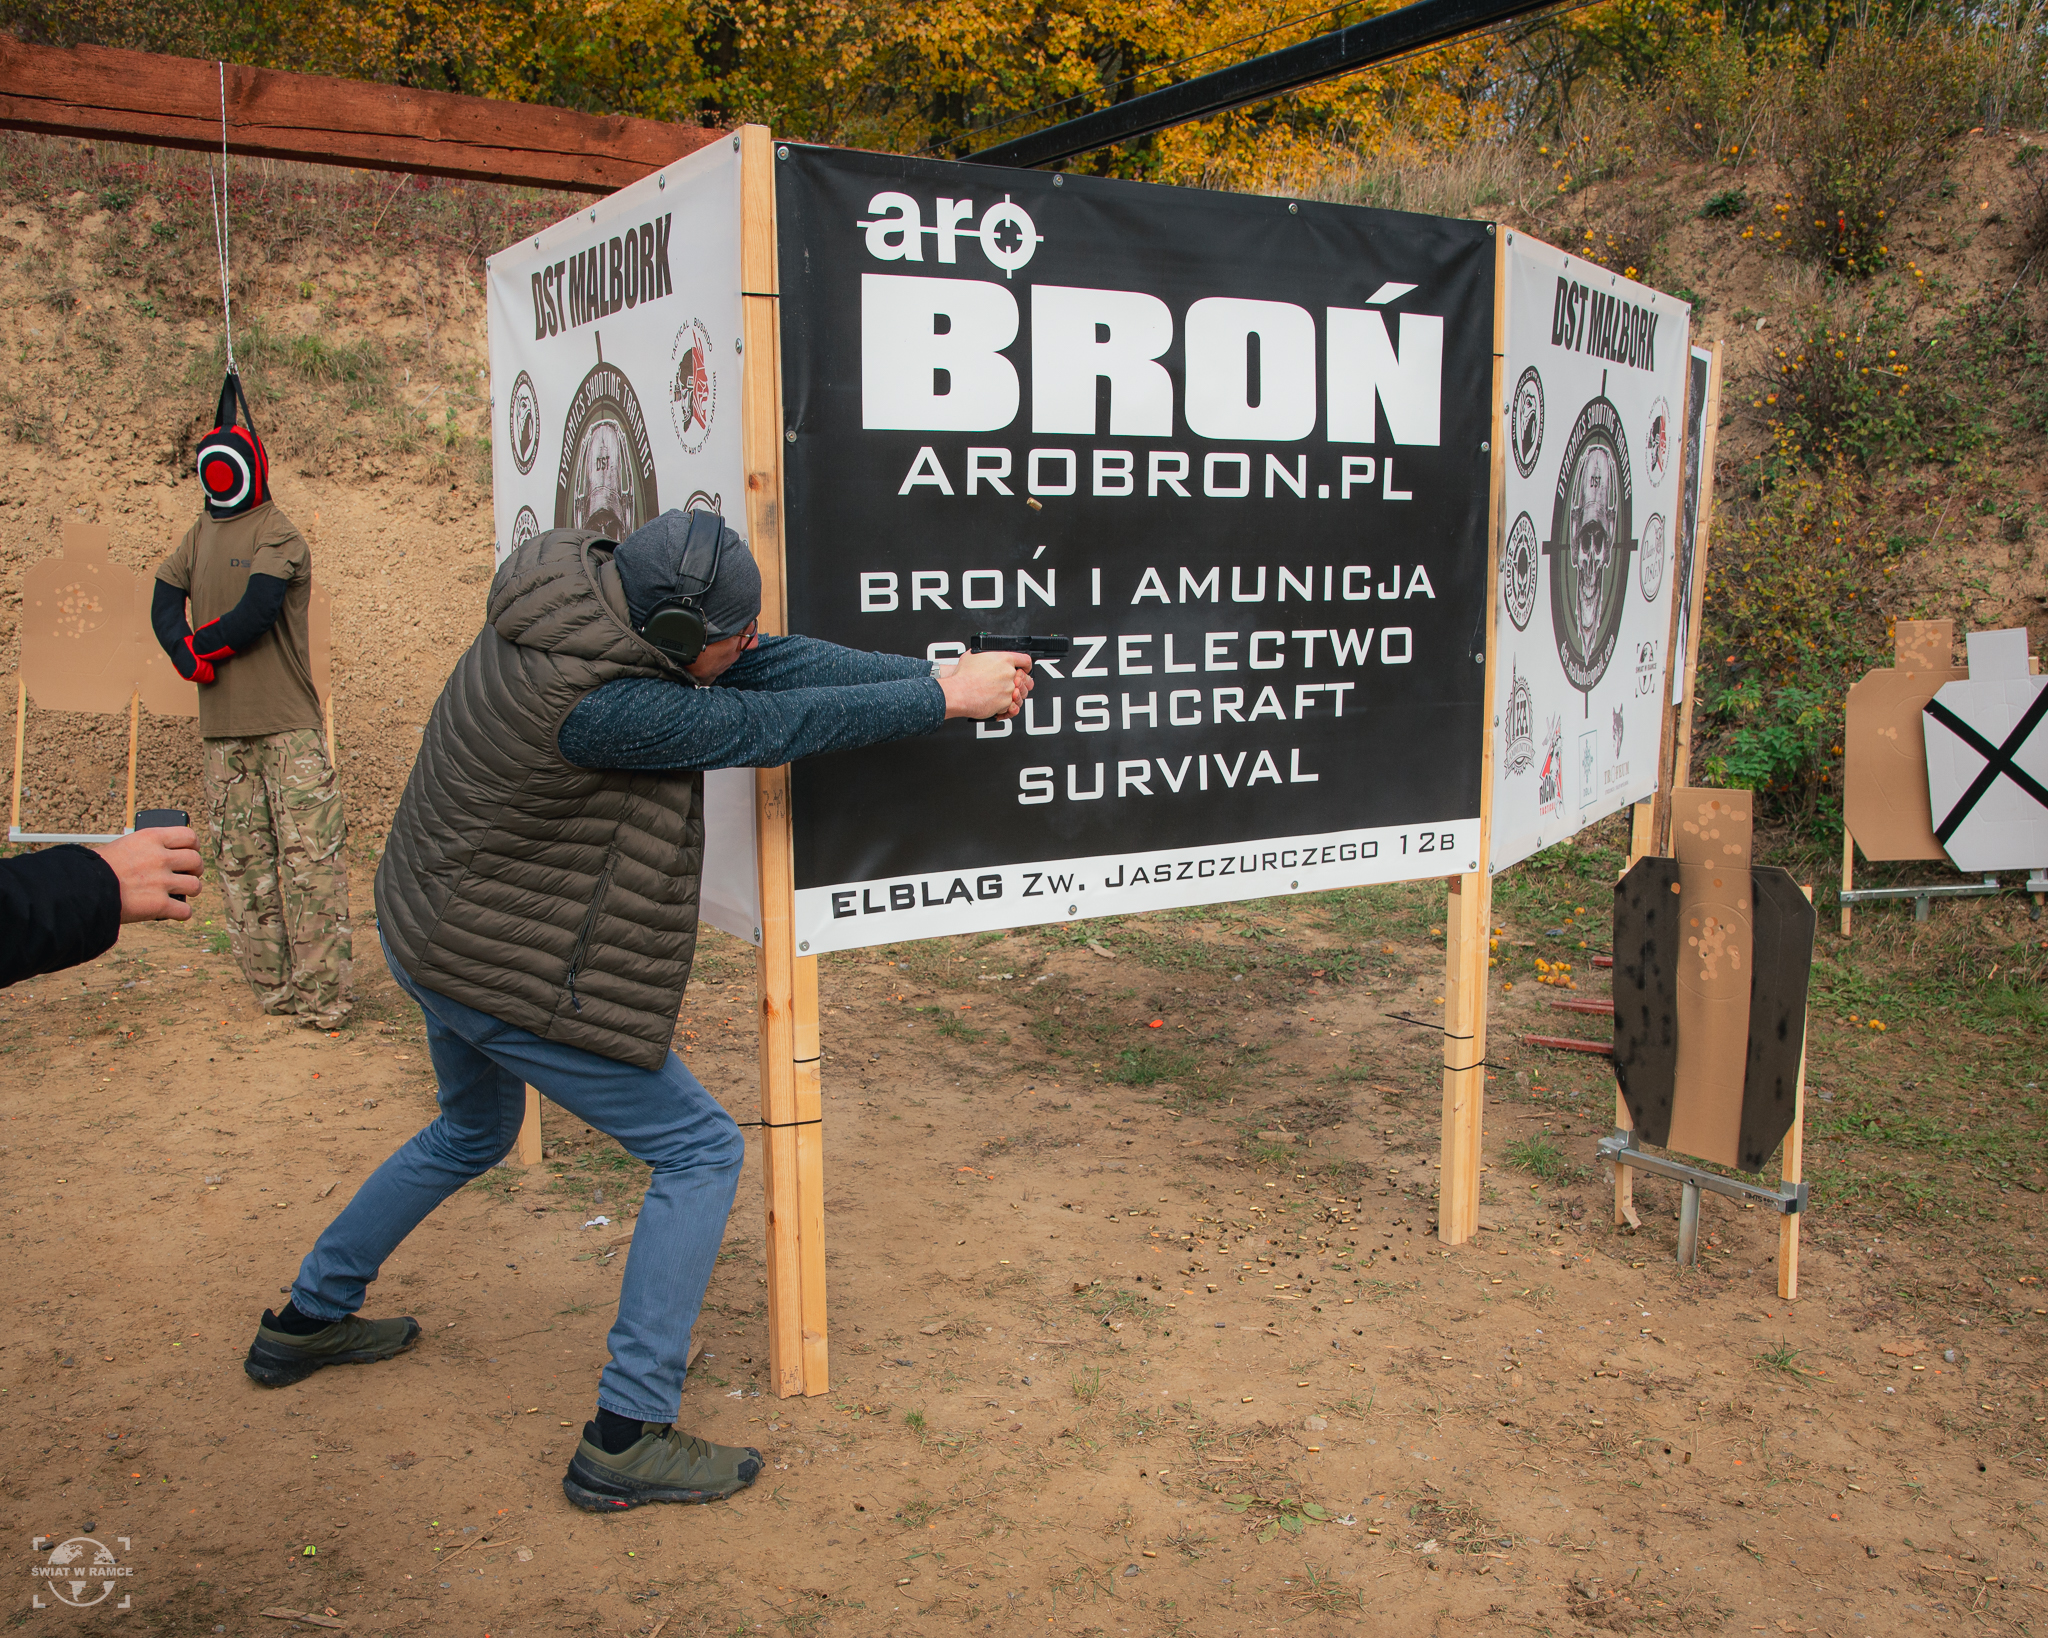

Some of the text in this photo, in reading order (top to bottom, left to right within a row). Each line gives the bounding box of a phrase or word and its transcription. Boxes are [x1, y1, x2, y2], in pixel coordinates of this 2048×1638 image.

[857, 191, 1043, 279] aro
[531, 212, 673, 341] DST MALBORK
[671, 317, 712, 360] TACTICAL BUSHIDO
[1551, 276, 1659, 372] DST MALBORK
[861, 273, 1444, 447] BROŃ
[559, 371, 653, 489] DYNAMICS SHOOTING TRAINING
[1558, 414, 1586, 500] DYNAMICS
[1587, 403, 1616, 434] SHOOTING
[1615, 421, 1632, 500] TRAINING
[596, 456, 610, 471] DST
[898, 446, 1412, 500] AROBRON.PL
[1590, 476, 1602, 488] DST
[859, 546, 1436, 613] BROŃ I AMUNICJA
[1506, 548, 1514, 598] CLOSE
[927, 626, 1413, 679] SZELECTWO
[1018, 749, 1319, 805] SURVIVAL
